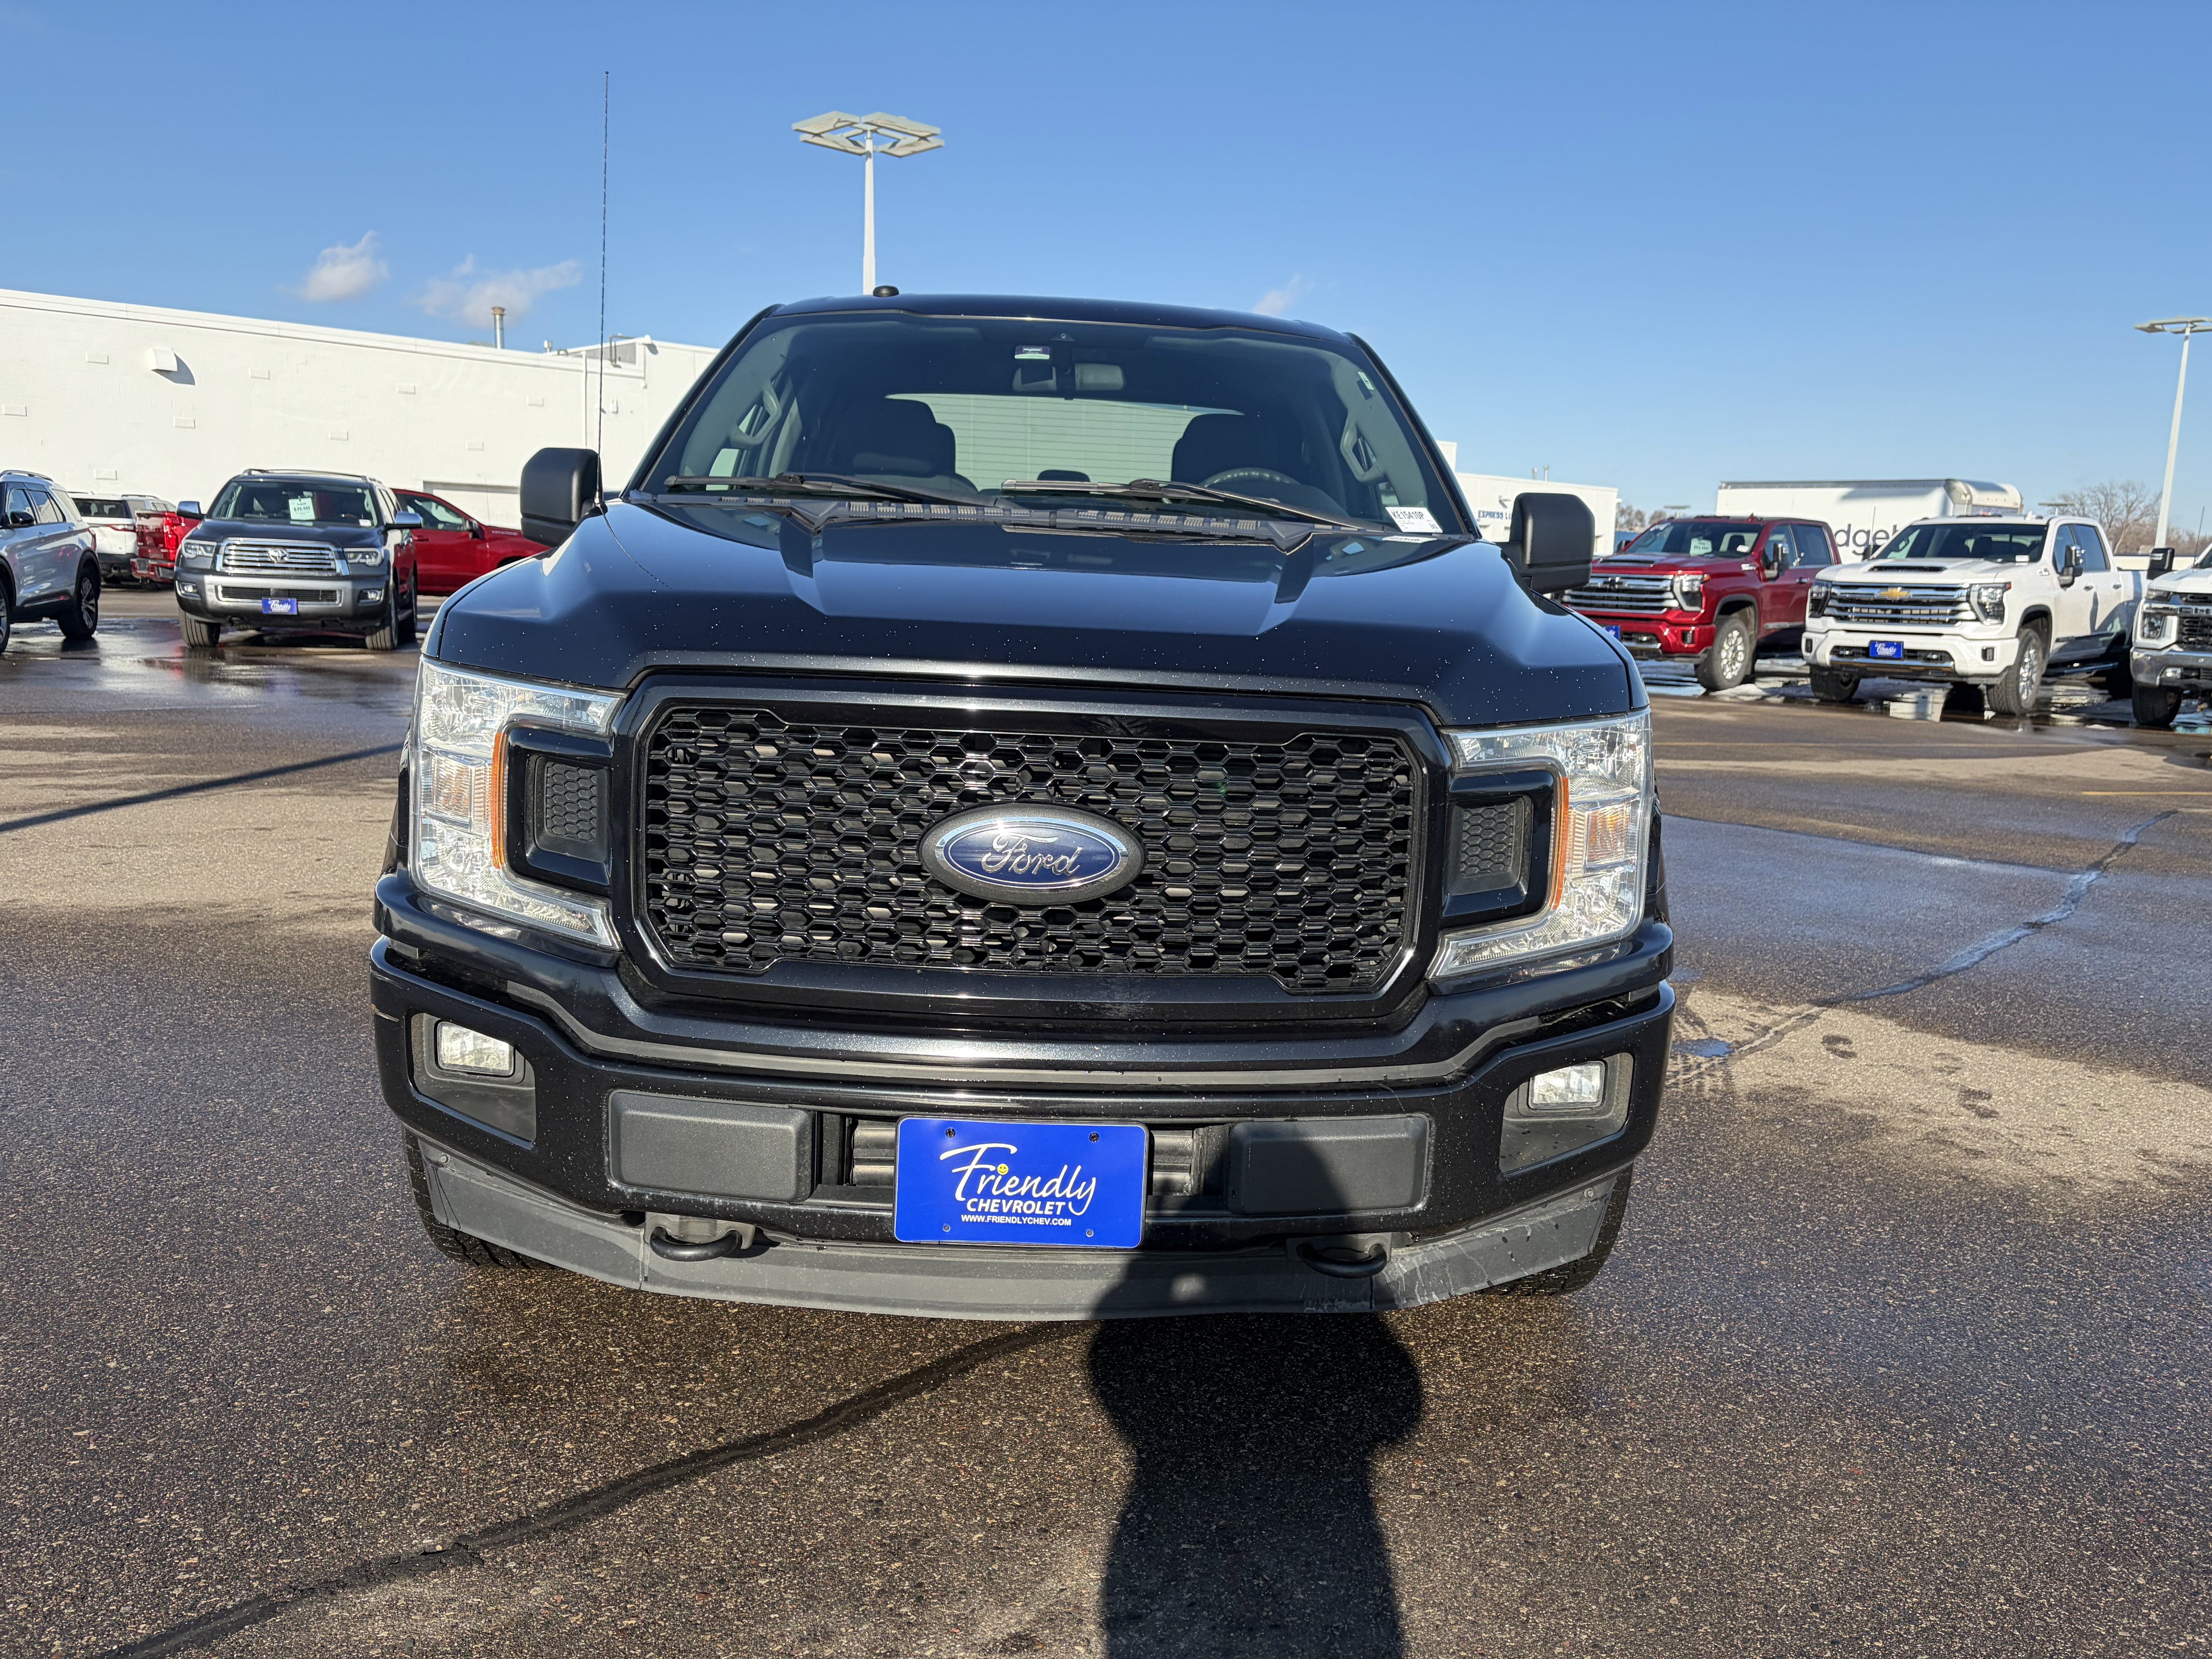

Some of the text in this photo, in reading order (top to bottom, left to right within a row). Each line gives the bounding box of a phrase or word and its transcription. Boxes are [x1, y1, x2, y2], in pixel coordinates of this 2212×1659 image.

[1391, 511, 1424, 520] KE15410P
[1478, 510, 1503, 520] EXPRESS
[981, 831, 1084, 876] Ford
[939, 1143, 1096, 1216] Friendly
[967, 1198, 1066, 1215] CHEVROLET
[961, 1214, 1072, 1226] WWW.FRIENDLYCHEV.COM
